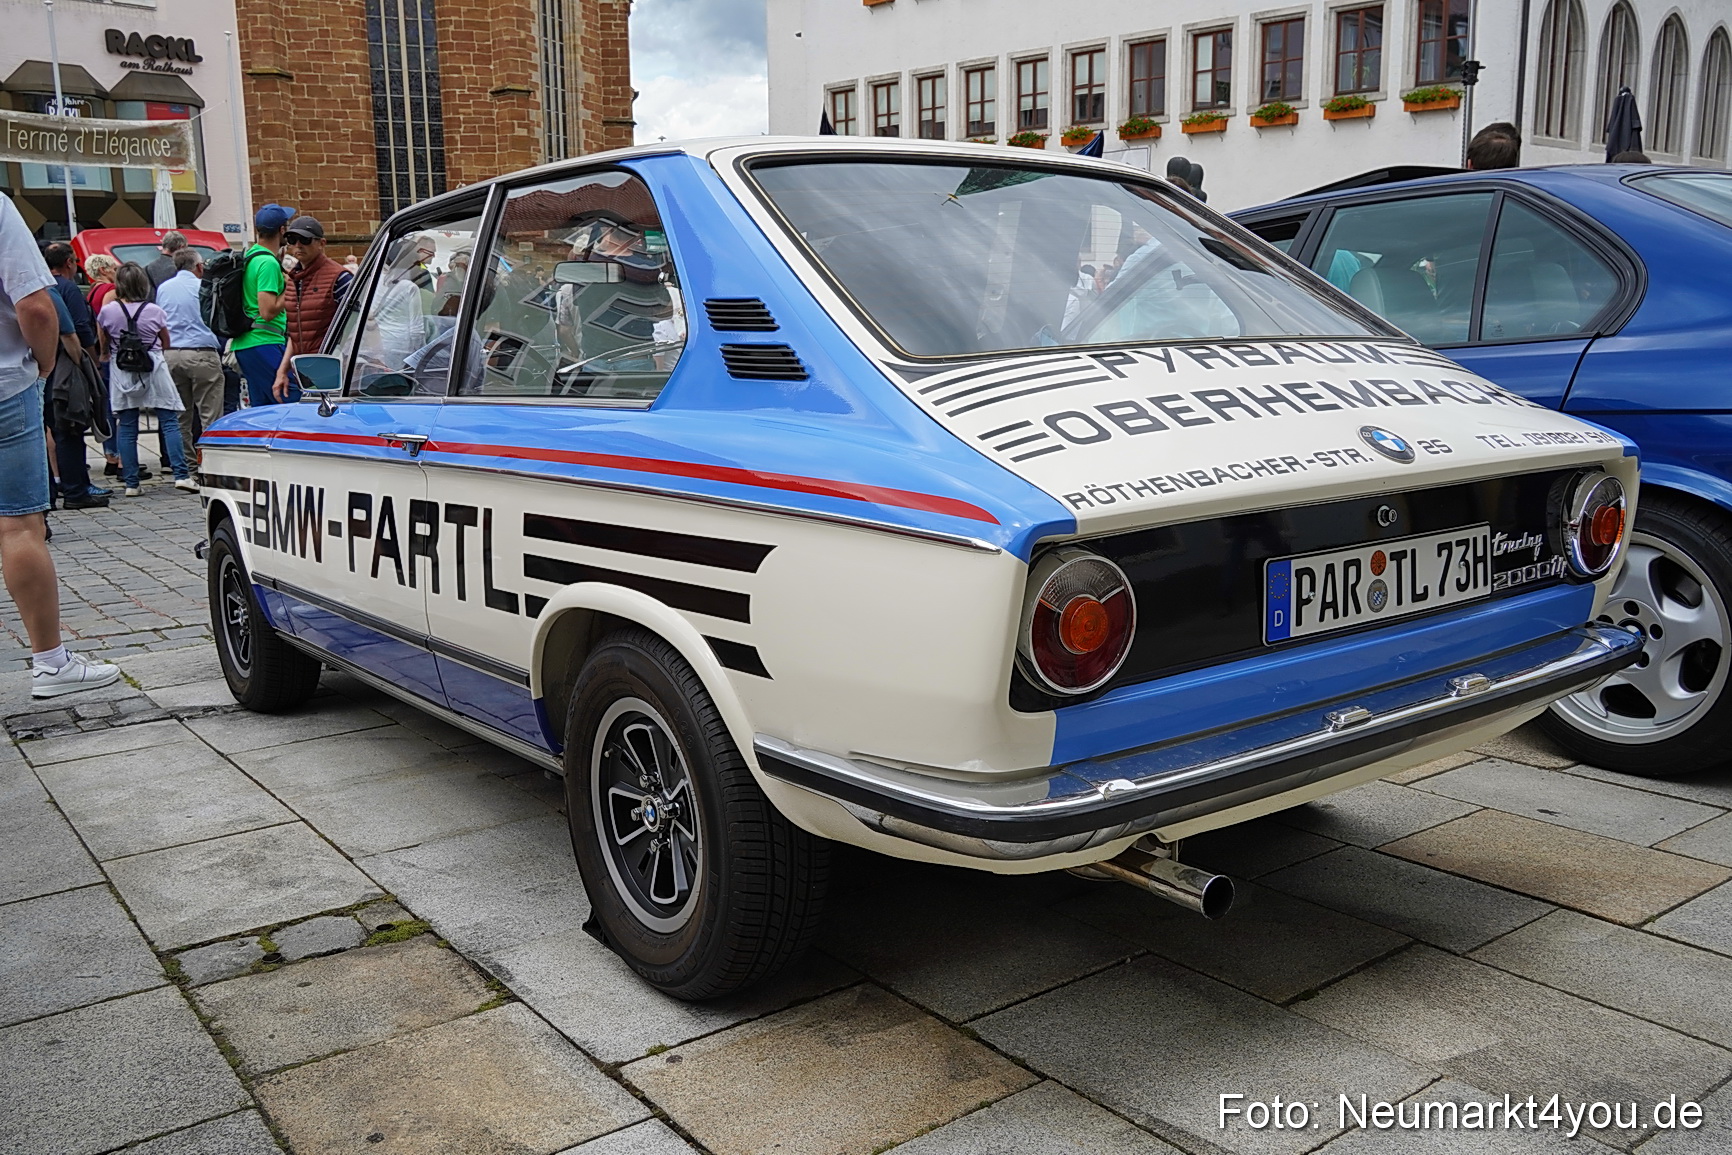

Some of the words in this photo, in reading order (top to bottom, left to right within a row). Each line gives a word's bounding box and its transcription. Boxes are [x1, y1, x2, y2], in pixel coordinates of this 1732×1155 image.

[104, 28, 203, 63] RACKL
[120, 58, 140, 71] am
[142, 58, 194, 76] Rathaus
[64, 97, 85, 106] Jahre
[7, 119, 68, 152] Fermé
[74, 127, 171, 165] d'Elégance
[1085, 342, 1402, 380] PYRBAUM
[1043, 379, 1508, 446] OBERHEMBACH
[1062, 447, 1375, 511] RÖTHENBACHER-STR.
[1416, 438, 1454, 455] 25
[1474, 433, 1527, 449] TEL.
[252, 477, 520, 616] BMW-PARTL
[1294, 557, 1362, 627] PAR
[1389, 547, 1429, 607] TL
[1436, 533, 1489, 597] 73H
[1274, 609, 1284, 628] D
